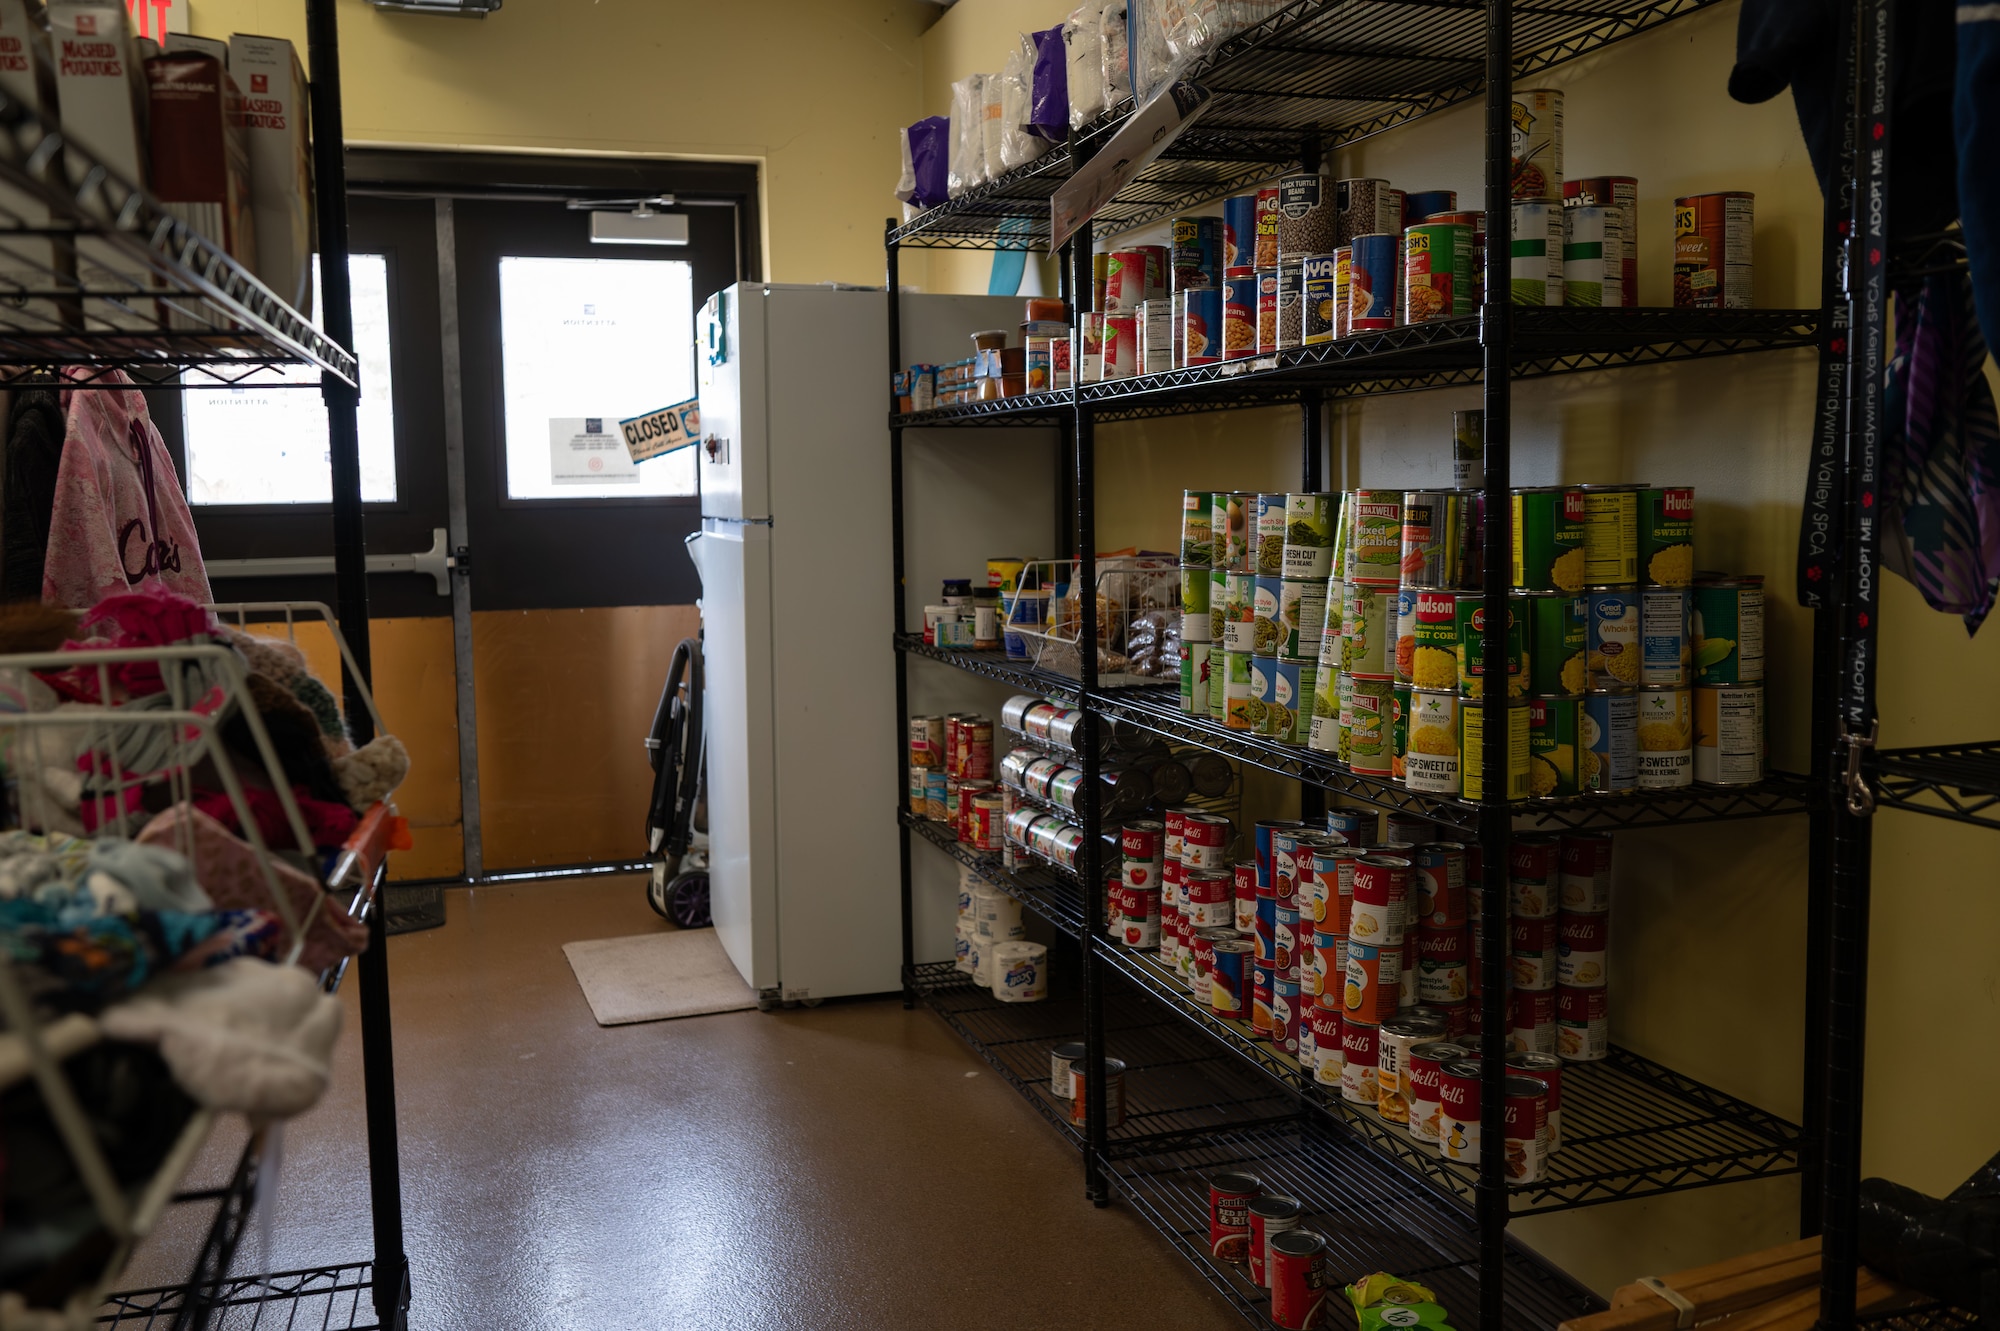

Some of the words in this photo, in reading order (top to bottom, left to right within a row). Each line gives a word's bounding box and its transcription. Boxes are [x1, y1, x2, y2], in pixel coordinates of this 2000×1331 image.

[62, 41, 115, 58] MASHED
[61, 59, 122, 76] POTATOES
[1872, 9, 1887, 114] Brandywine
[1871, 148, 1884, 175] ME
[1296, 180, 1318, 188] TURTLE
[1288, 188, 1306, 196] BEANS
[1870, 180, 1883, 237] ADOPT
[1676, 241, 1703, 253] Sweet
[1867, 275, 1880, 322] SPCA
[1832, 305, 1849, 329] ME
[1866, 326, 1880, 379] Valley
[1820, 362, 1846, 457] Brandywine
[625, 411, 679, 445] CLOSED
[1862, 381, 1879, 482] Brandywine
[1811, 460, 1836, 510] Valley
[1364, 505, 1396, 517] MAXWELL
[1357, 524, 1386, 535] Mixed
[1809, 512, 1830, 555] SPCA
[1860, 516, 1872, 542] ME
[1302, 550, 1317, 560] CUT
[1297, 560, 1313, 568] BEANS
[1859, 548, 1872, 602] ADOPT
[1416, 596, 1453, 614] Hudson
[1599, 604, 1622, 613] Great
[1419, 713, 1450, 723] FREEDOM'S
[1641, 711, 1675, 719] FREEDOM'S
[1420, 762, 1446, 773] SWEET
[1646, 757, 1674, 768] SWEET
[1676, 756, 1691, 768] CORN
[1429, 774, 1451, 782] KERNEL
[1659, 769, 1681, 777] KERNEL
[1429, 983, 1450, 992] Noodle
[1219, 1209, 1235, 1217] RED
[1221, 1216, 1230, 1224] &
